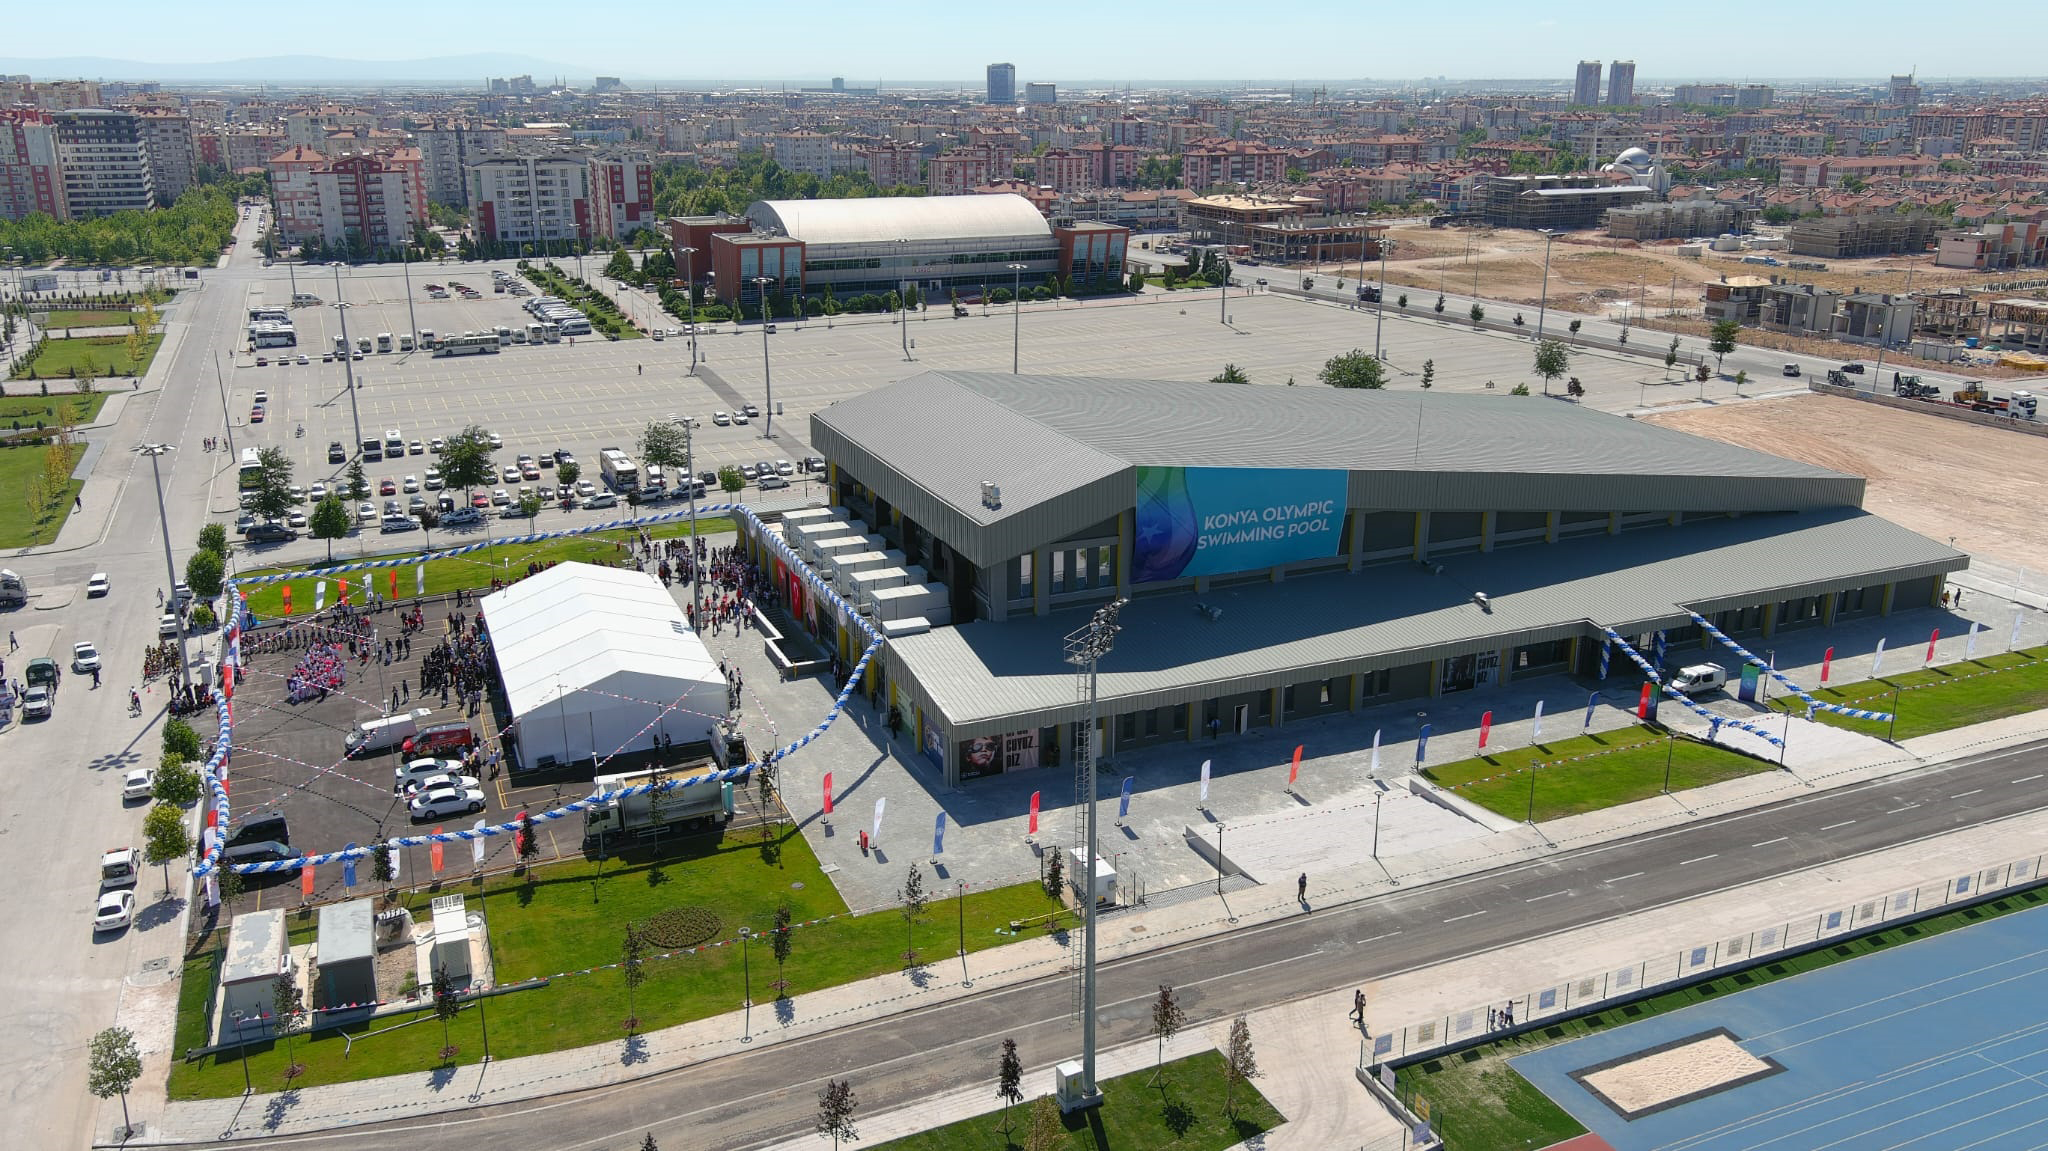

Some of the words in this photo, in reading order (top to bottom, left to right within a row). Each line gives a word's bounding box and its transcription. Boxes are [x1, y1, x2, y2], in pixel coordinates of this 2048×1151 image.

[1204, 509, 1259, 531] KONYA
[1262, 500, 1334, 522] OLYMPIC
[1198, 525, 1285, 550] SWIMMING
[1288, 518, 1330, 538] POOL
